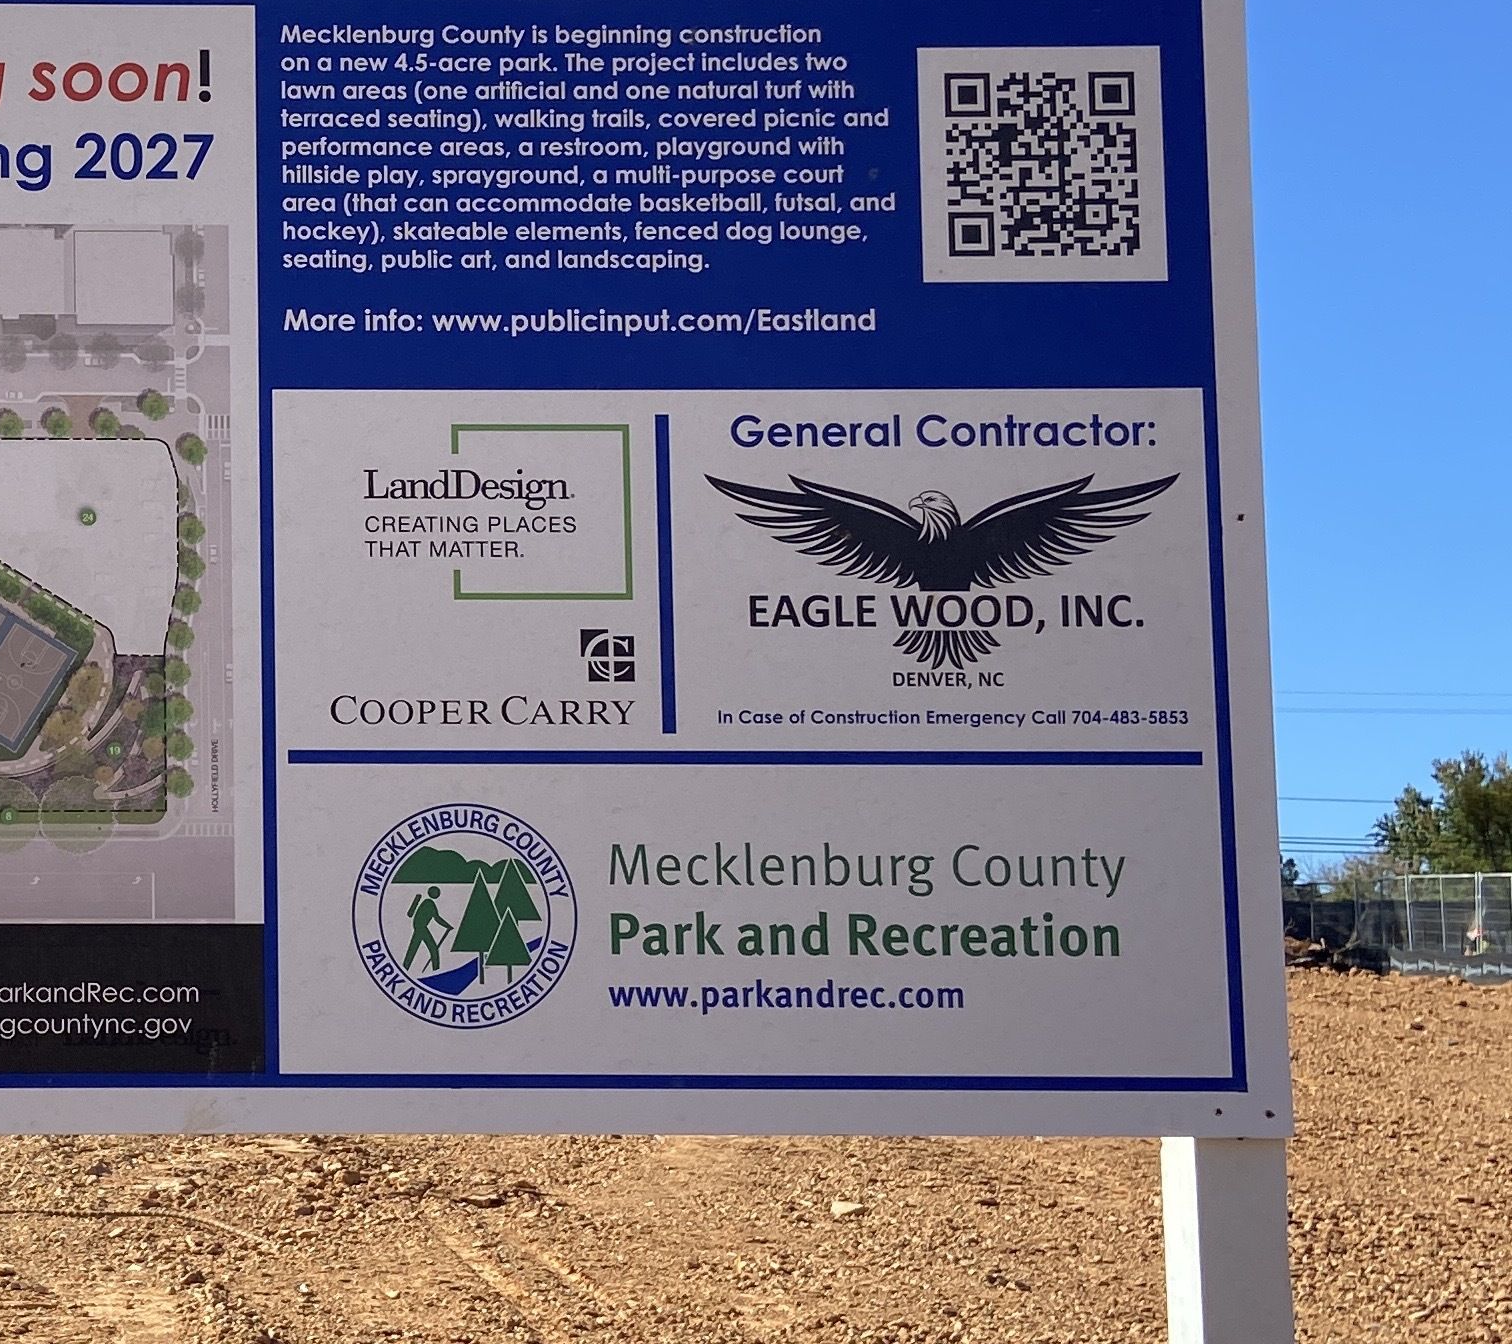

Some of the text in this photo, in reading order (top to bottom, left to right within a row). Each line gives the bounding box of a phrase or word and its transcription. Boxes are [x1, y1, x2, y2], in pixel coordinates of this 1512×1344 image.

[280, 24, 821, 47] Mecklenburg County is beginning construction
[27, 49, 211, 101] soon!
[280, 52, 847, 75] on a new 4.5-acre park. The project includes two
[281, 79, 854, 104] lawn areas (one artificial and one natural turf with
[280, 108, 888, 132] terraced seating), walking trails, covered picnic and
[74, 132, 214, 179] 2027
[281, 136, 844, 159] performance areas, a restroom, playground with
[282, 164, 844, 188] hillside play, sprayground, a multi-purpose court
[282, 192, 895, 216] area (that can accommodate basketball, futsal, and
[282, 221, 867, 244] hockey), skateable elements, fenced dog lounge,
[282, 249, 709, 272] seating, public art, and landscaping.
[283, 308, 875, 335] More info: www.publicinput.com/Eastland
[730, 414, 1156, 447] General Contractor:
[365, 515, 576, 532] CREATING PLACES
[364, 540, 524, 557] THAT MATTER.
[749, 594, 1143, 635] EAGLE WOOD, INC.
[892, 672, 1004, 688] DENVER, NC
[330, 695, 635, 724] COOPER CARRY
[718, 709, 1188, 727] In Case of Construction Emergency Call 704-483-5853
[360, 809, 569, 899] MECKLENBURG COUNTY
[609, 842, 1125, 897] Mecklenburg County
[610, 911, 1120, 956] Park and Recreation
[362, 939, 569, 1023] PARK AND RECREATION
[608, 979, 964, 1013] www.parkandrec.com
